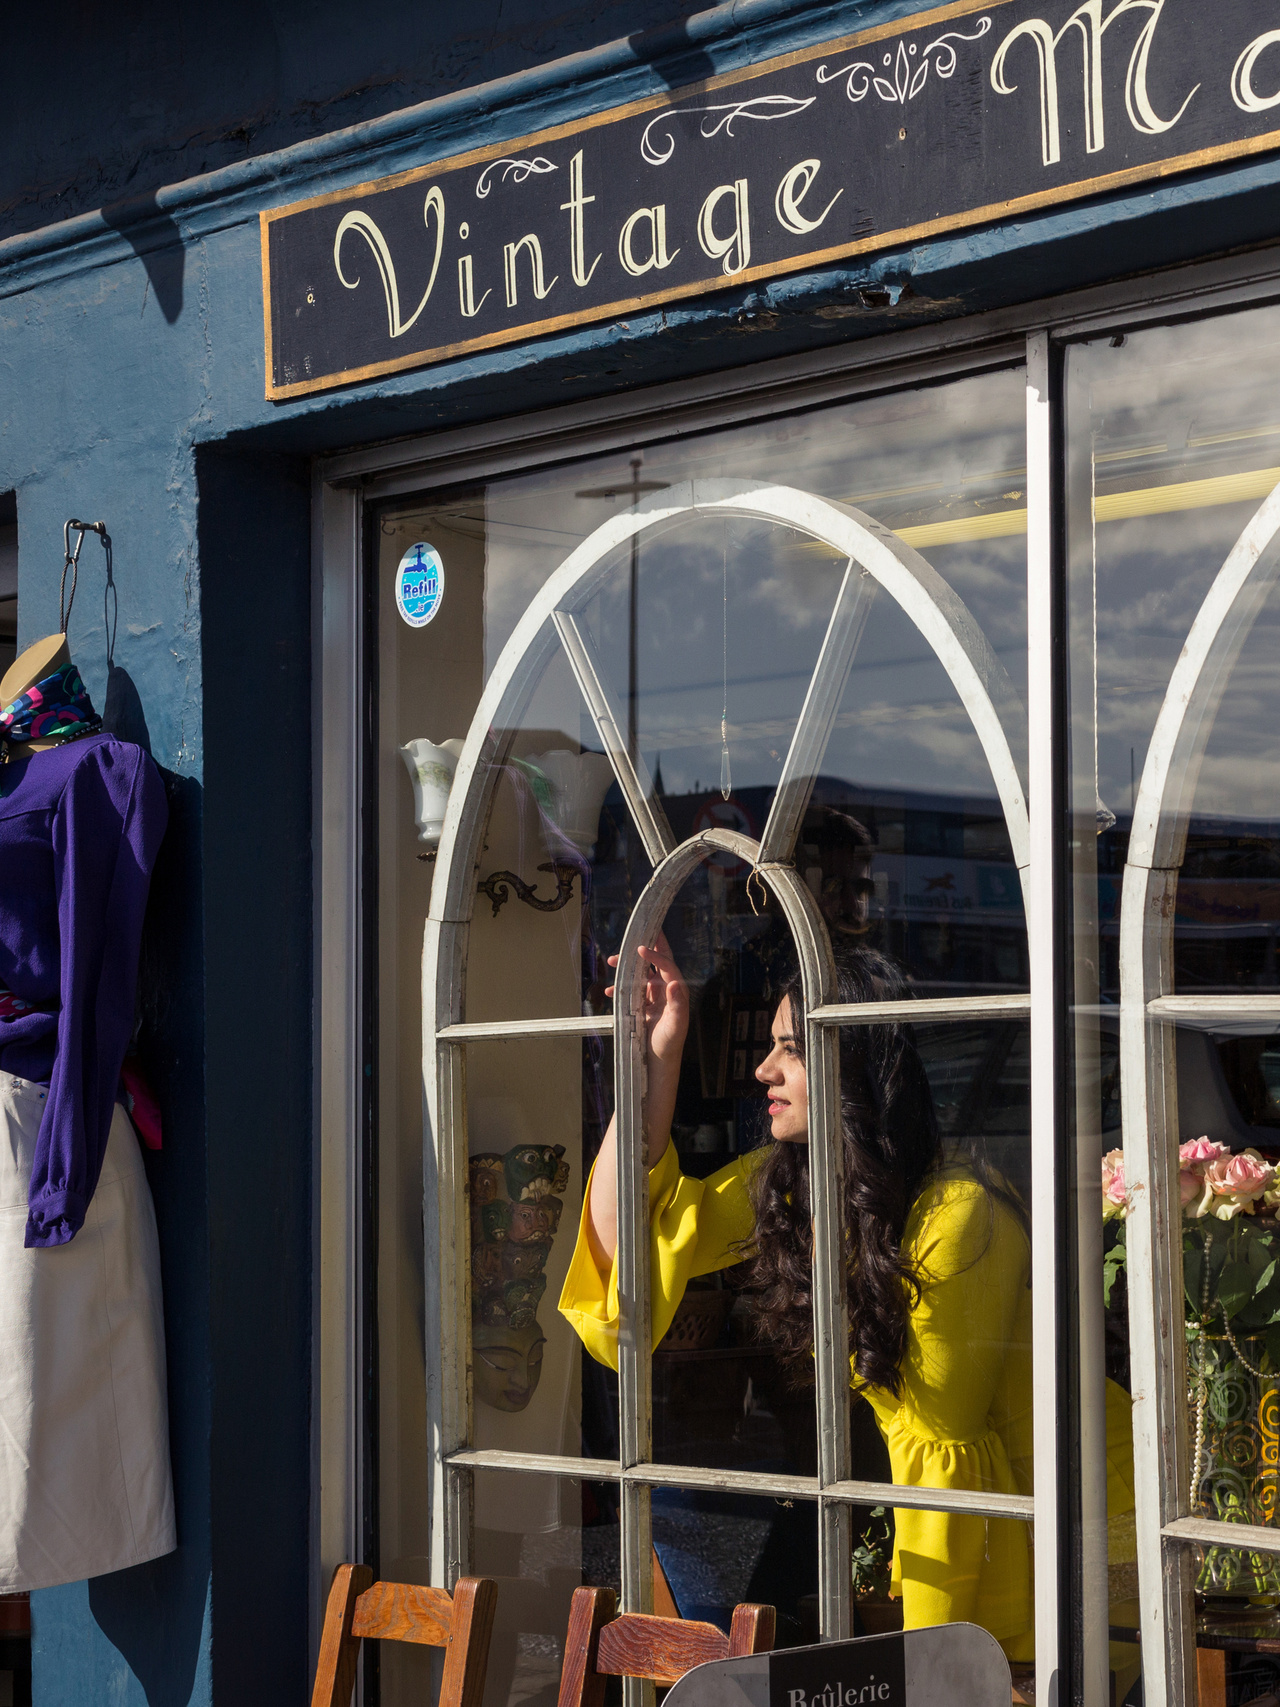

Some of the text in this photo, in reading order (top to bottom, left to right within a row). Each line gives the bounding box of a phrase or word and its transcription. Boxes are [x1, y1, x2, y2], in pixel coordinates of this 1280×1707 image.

[333, 148, 845, 339] Vintage
[403, 576, 436, 599] Refill
[787, 1674, 890, 1707] Brûlerie
